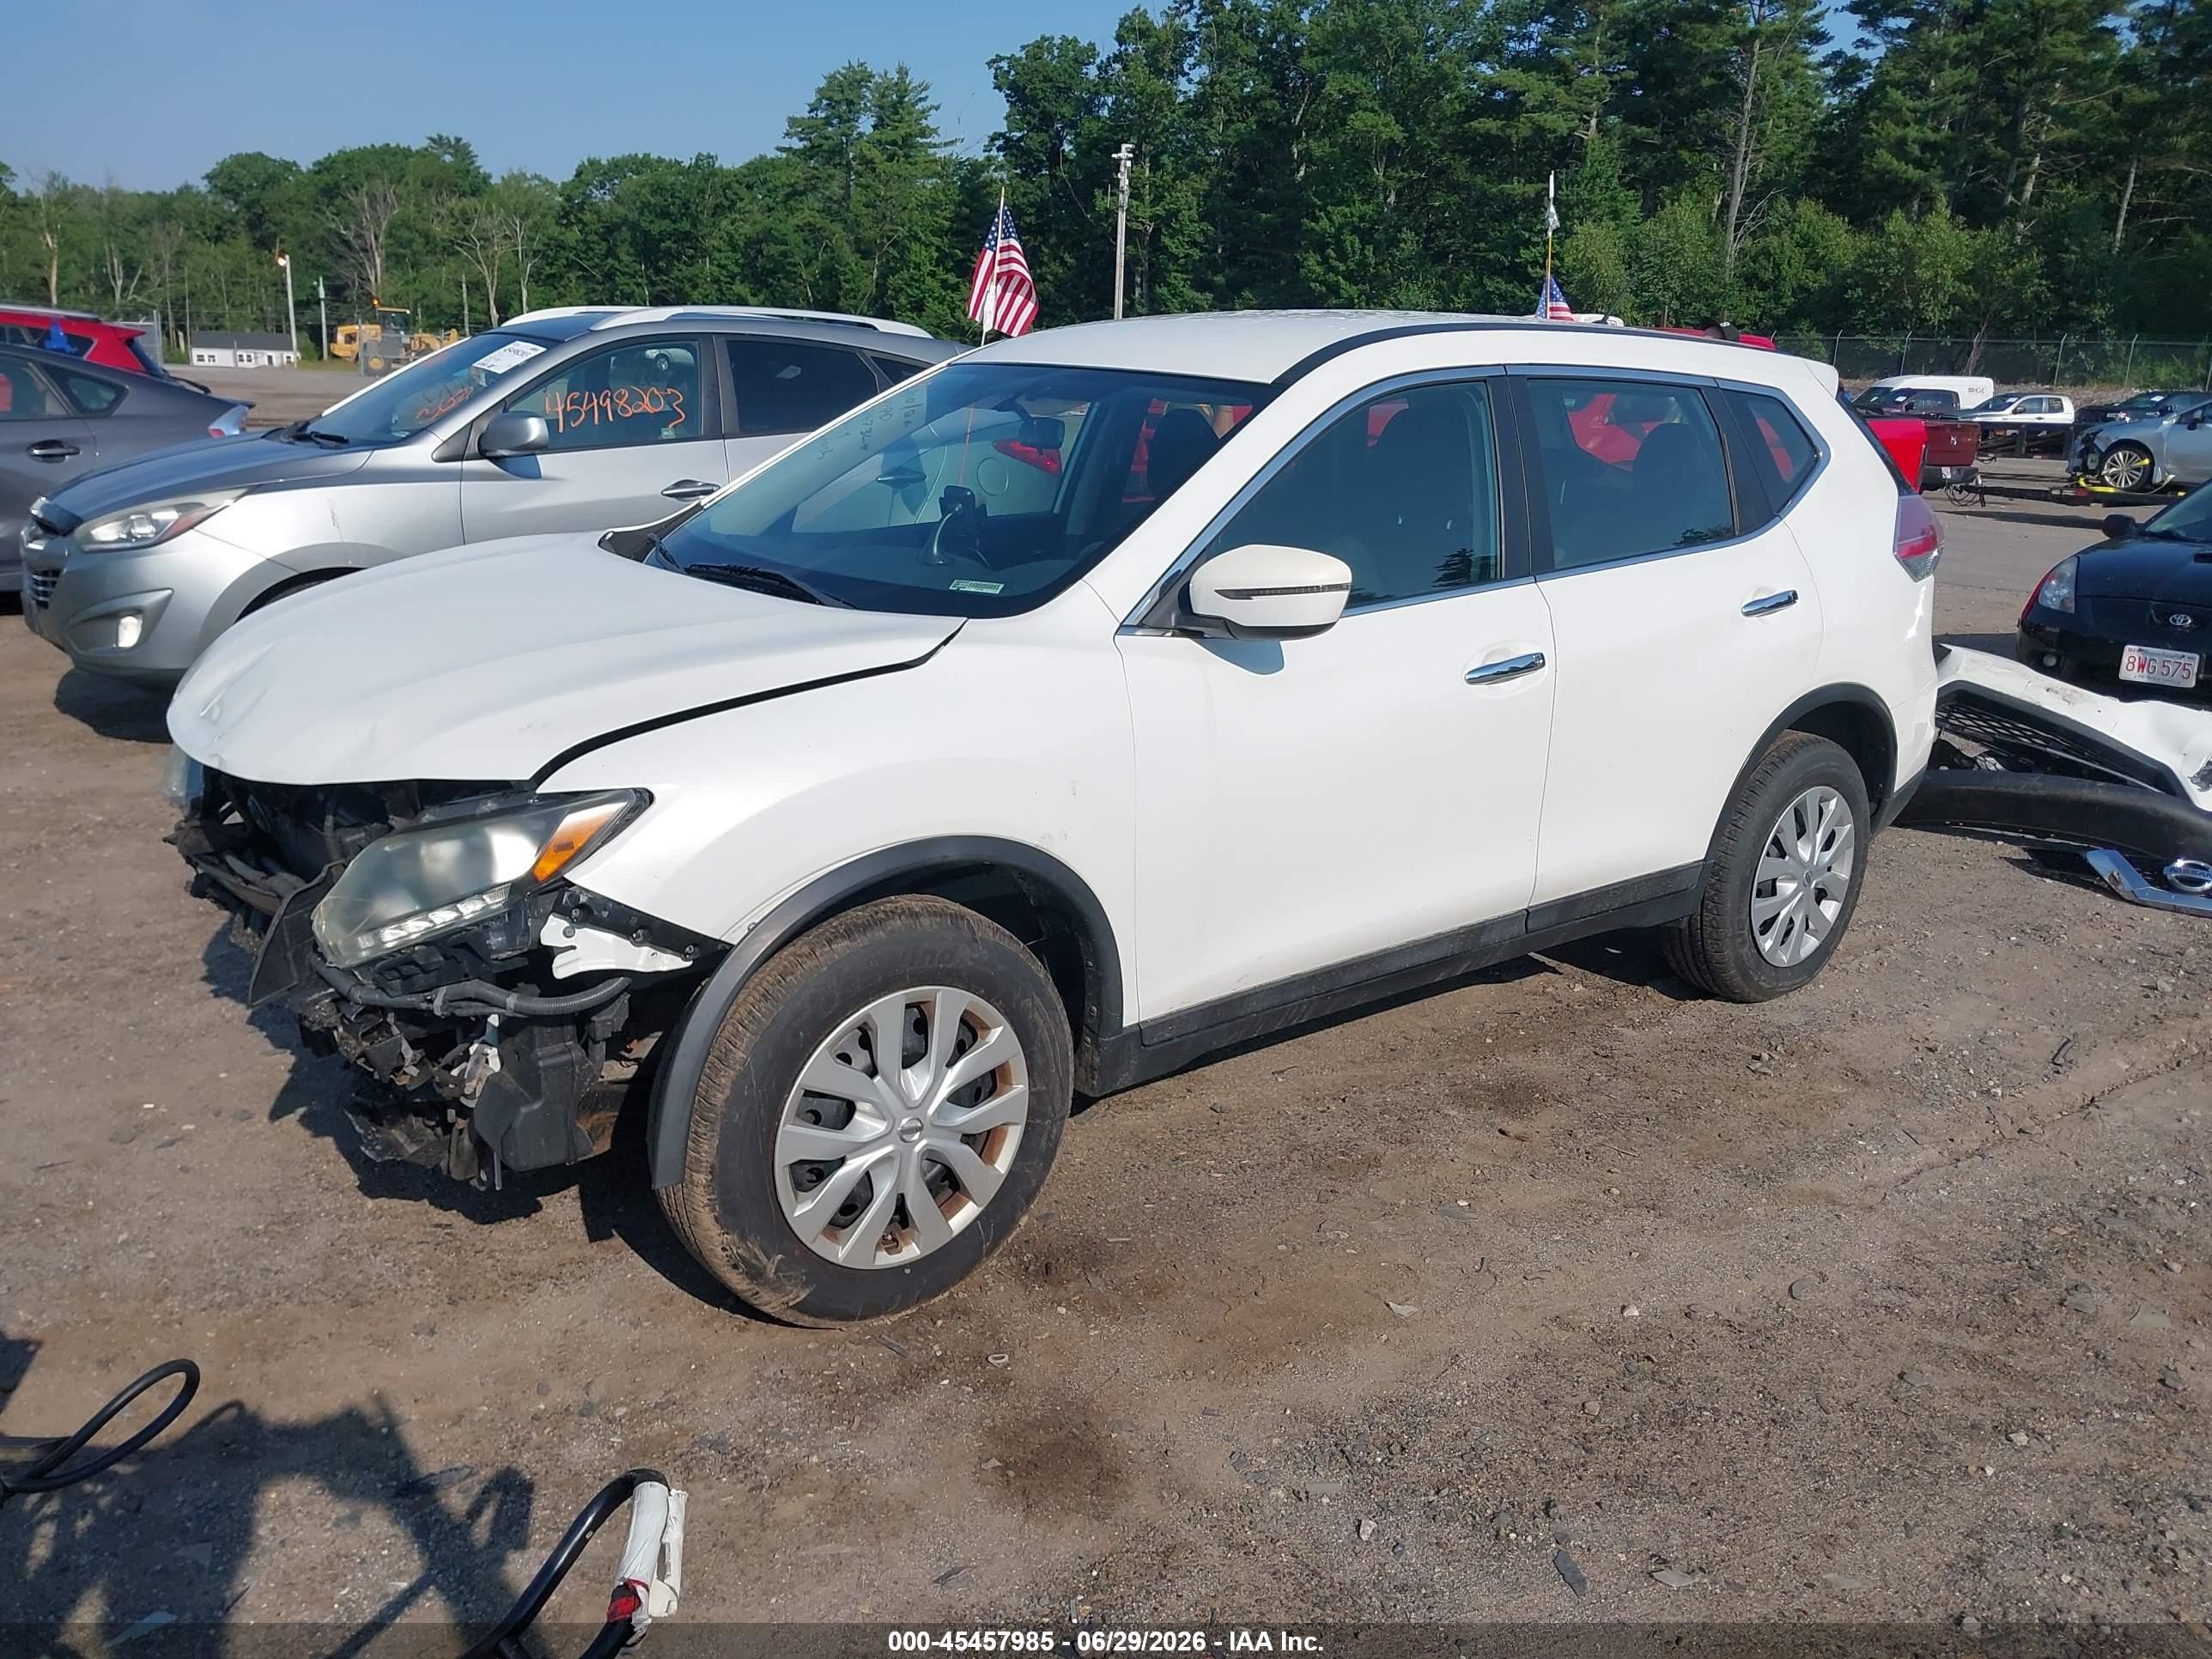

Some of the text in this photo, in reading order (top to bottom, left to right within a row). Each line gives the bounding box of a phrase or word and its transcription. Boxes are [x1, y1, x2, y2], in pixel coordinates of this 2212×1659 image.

[546, 386, 686, 434] 45498203
[2125, 655, 2158, 674] 8WG
[2161, 659, 2193, 679] 575
